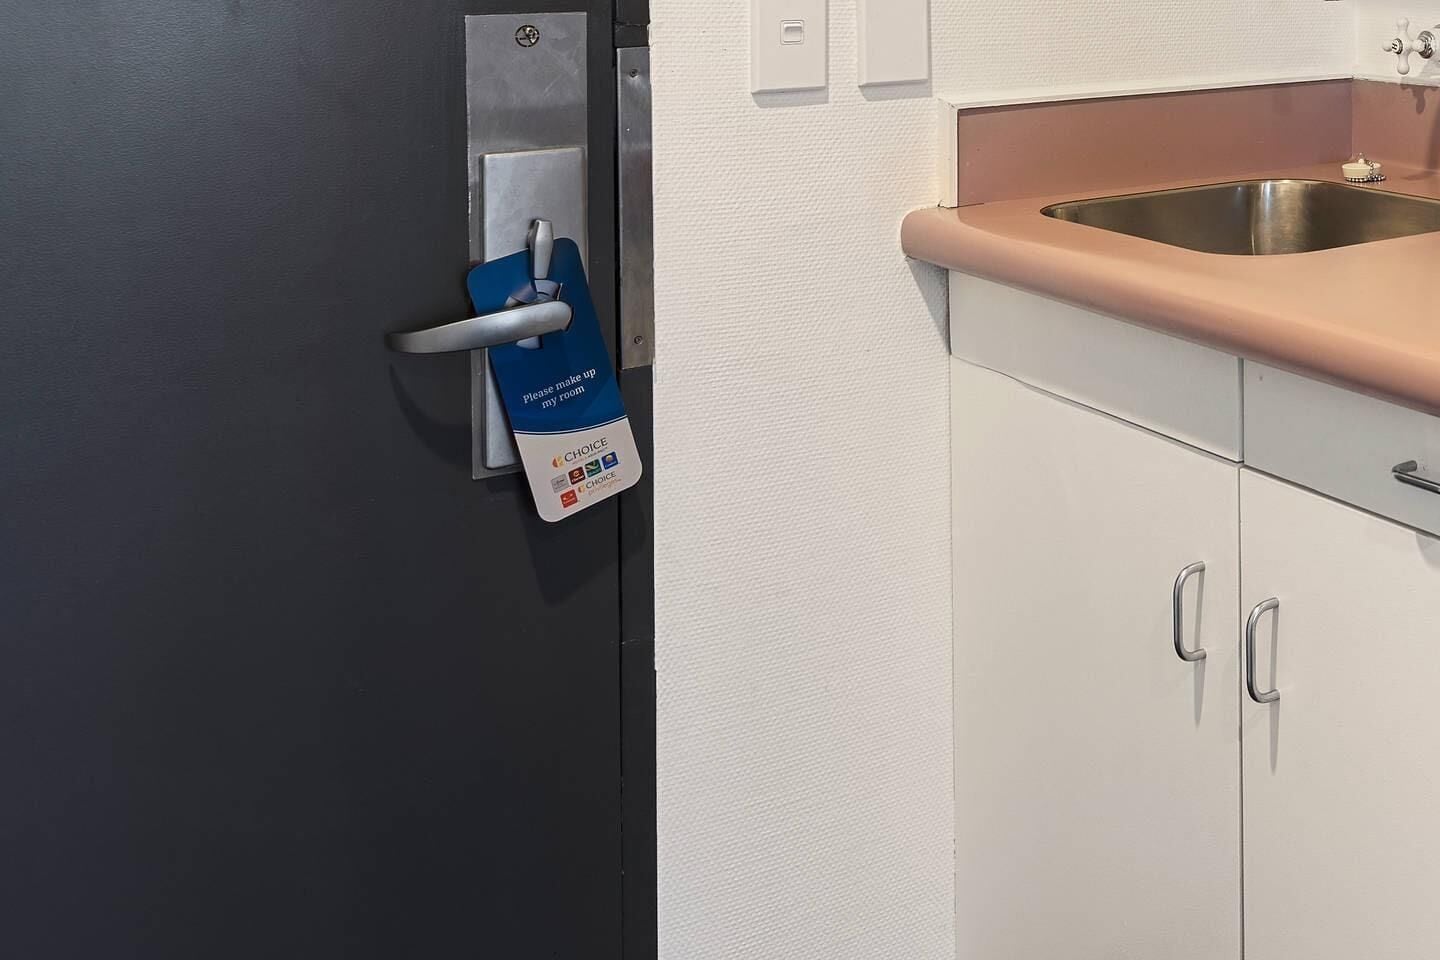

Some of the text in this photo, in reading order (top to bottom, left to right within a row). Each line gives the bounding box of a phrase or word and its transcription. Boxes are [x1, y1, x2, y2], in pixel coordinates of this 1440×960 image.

[523, 368, 596, 404] Please make up
[542, 385, 585, 409] my room
[564, 437, 609, 462] CHOICE
[586, 471, 617, 489] CHOICE
